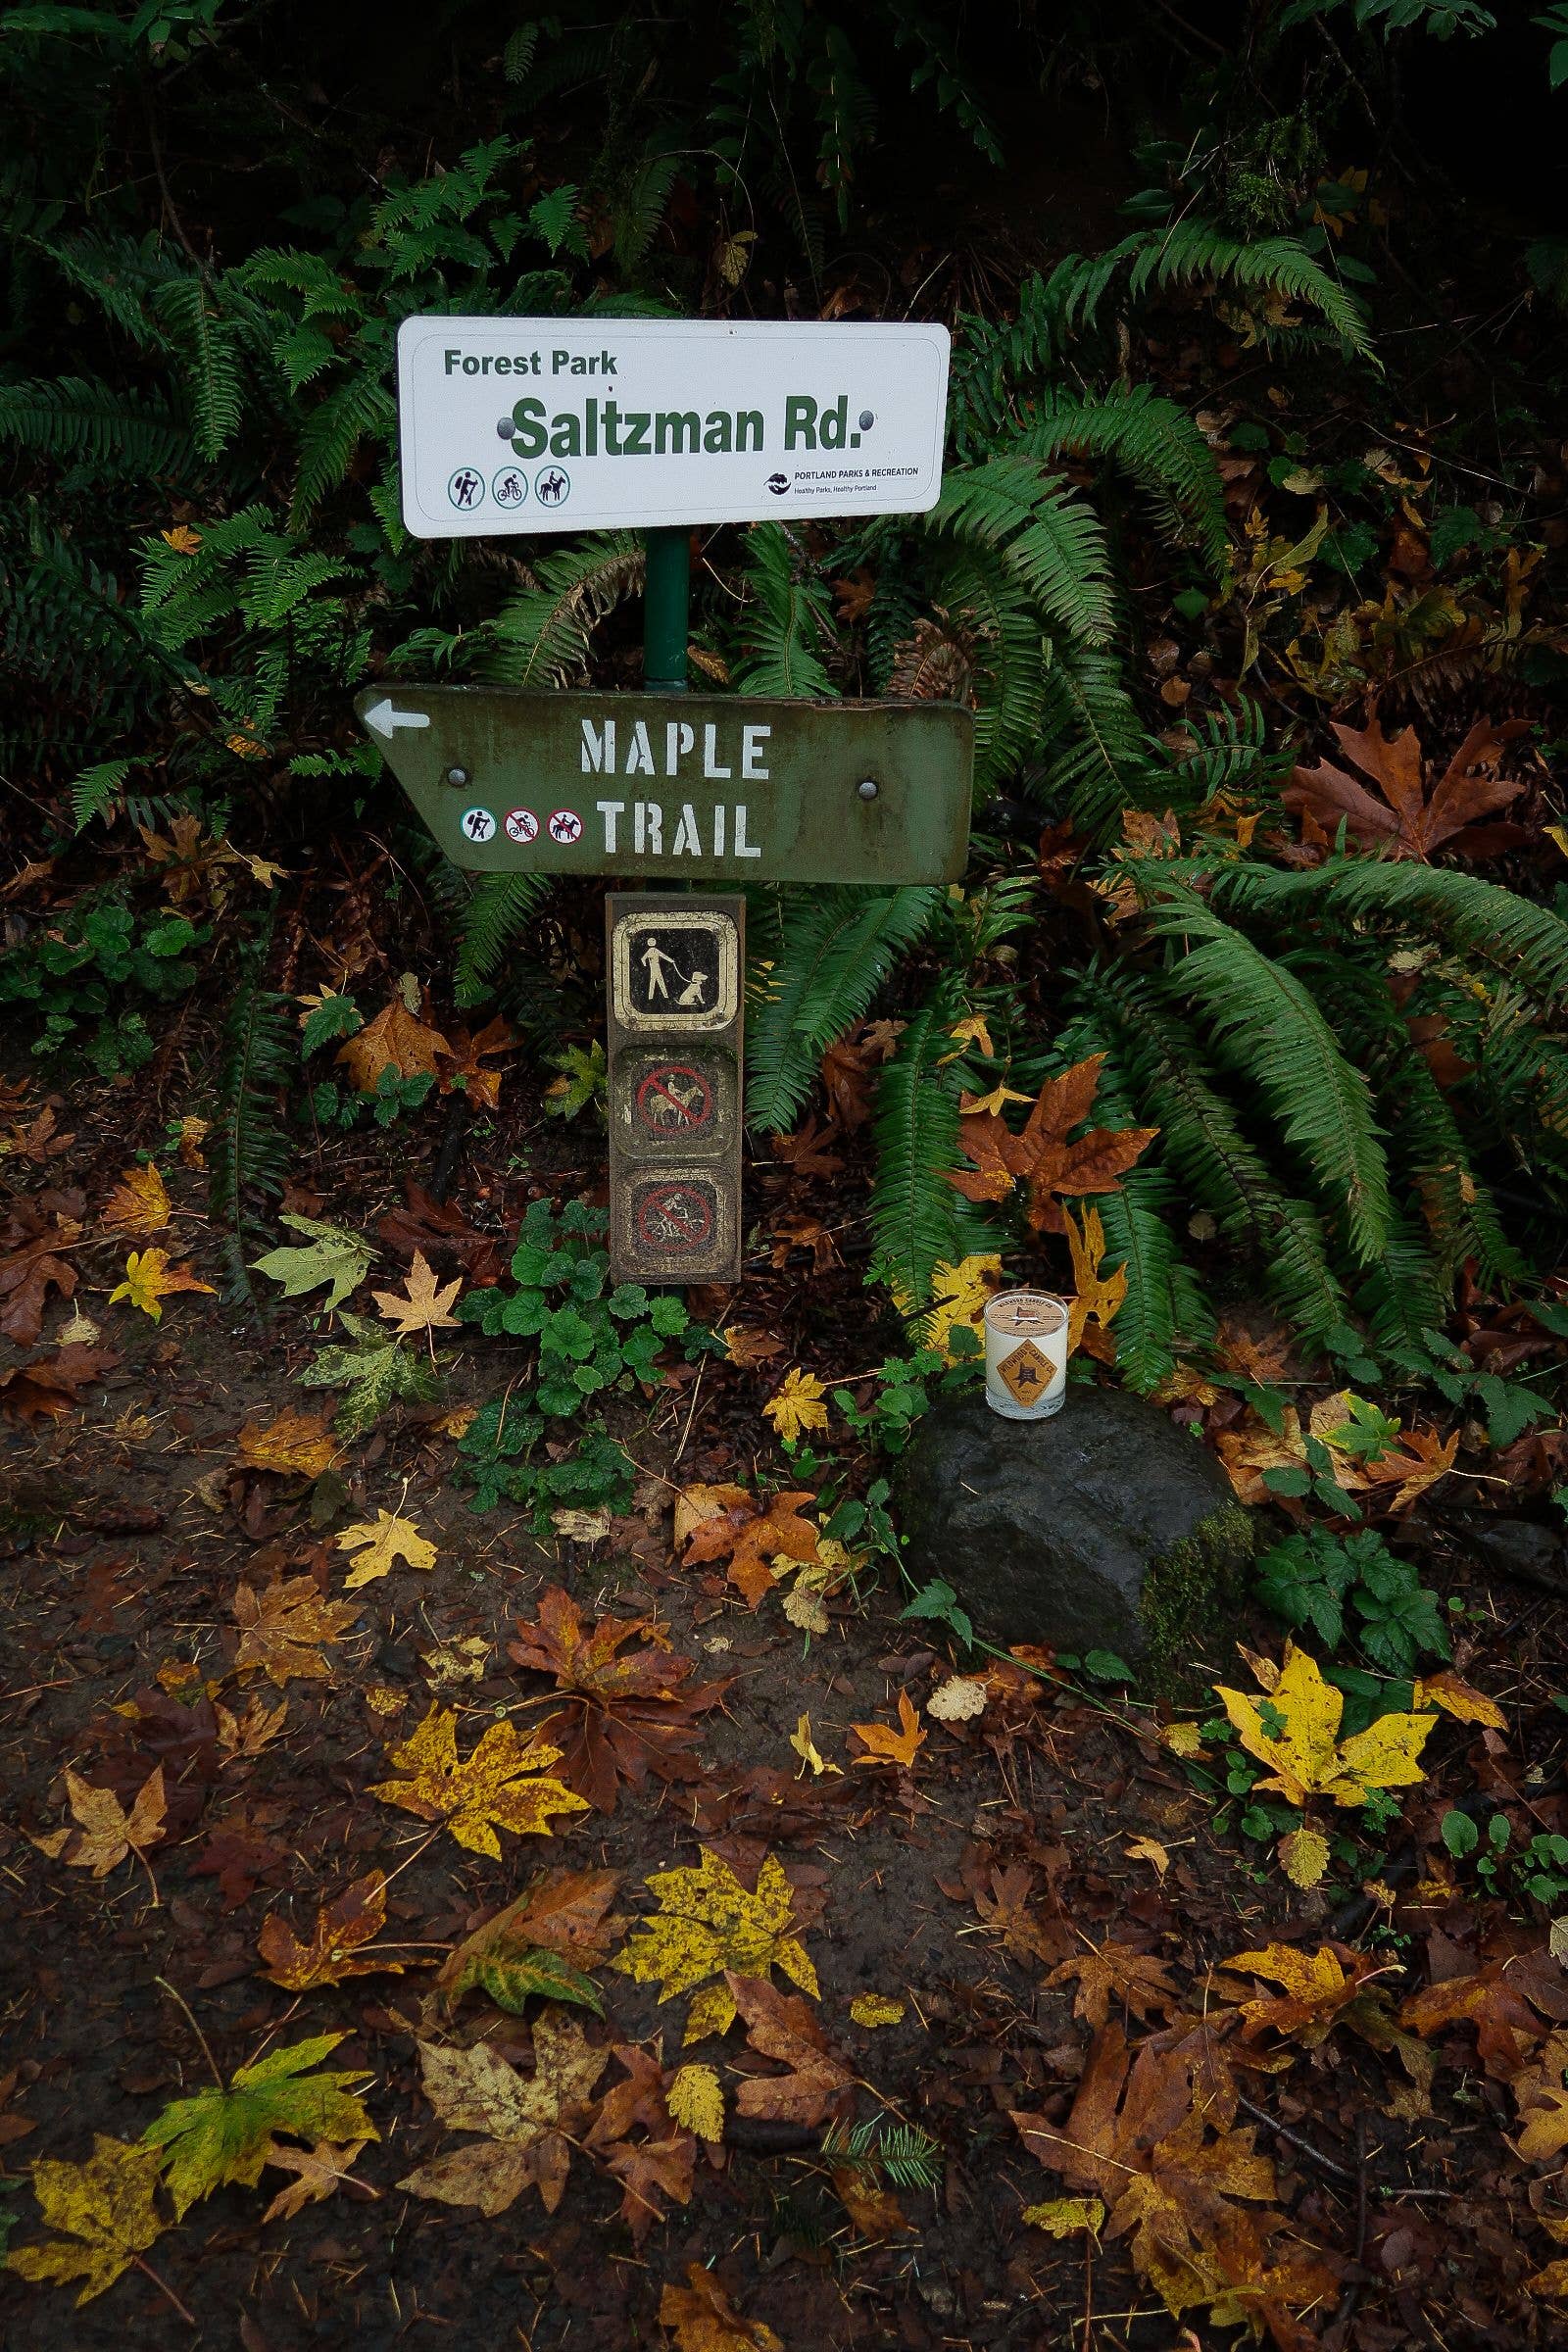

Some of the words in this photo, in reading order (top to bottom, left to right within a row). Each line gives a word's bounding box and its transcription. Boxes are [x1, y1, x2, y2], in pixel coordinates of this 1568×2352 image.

[444, 348, 542, 375] Forest
[551, 349, 618, 375] Park
[510, 396, 764, 460] Saltzman
[784, 394, 861, 451] Rd.
[794, 470, 837, 480] PORTLAND
[838, 469, 863, 478] PARKS
[864, 468, 870, 477] &
[871, 466, 919, 477] RECREATION
[581, 718, 772, 780] MAPLE
[597, 801, 761, 858] TRAIL
